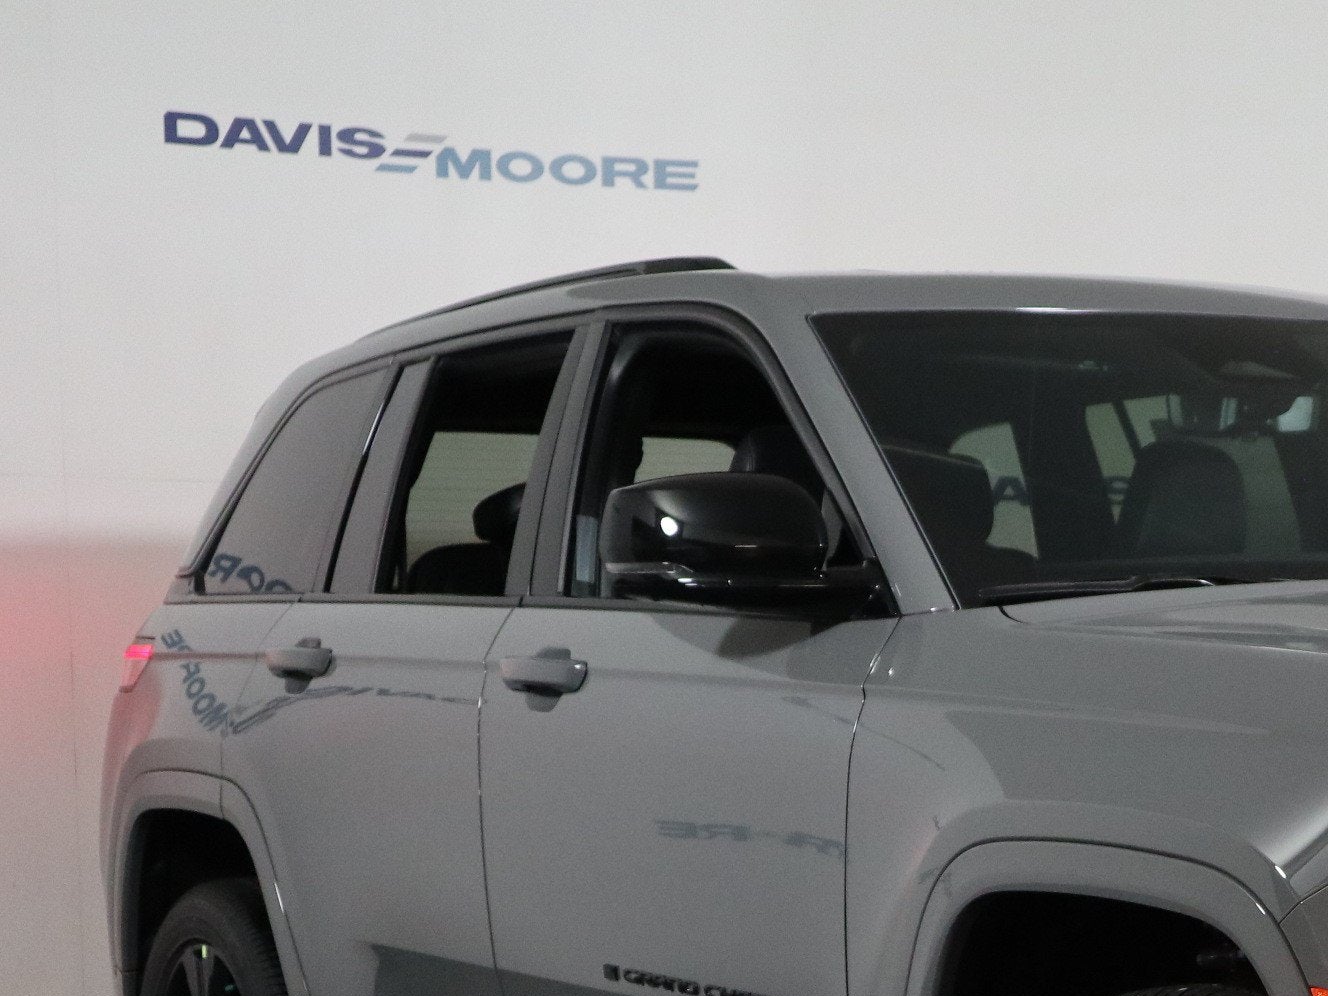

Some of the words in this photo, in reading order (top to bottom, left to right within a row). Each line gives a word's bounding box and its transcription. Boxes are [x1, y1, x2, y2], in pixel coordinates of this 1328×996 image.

[164, 111, 387, 160] DAVIS
[435, 147, 700, 192] MOORE
[623, 968, 700, 996] GRAND
